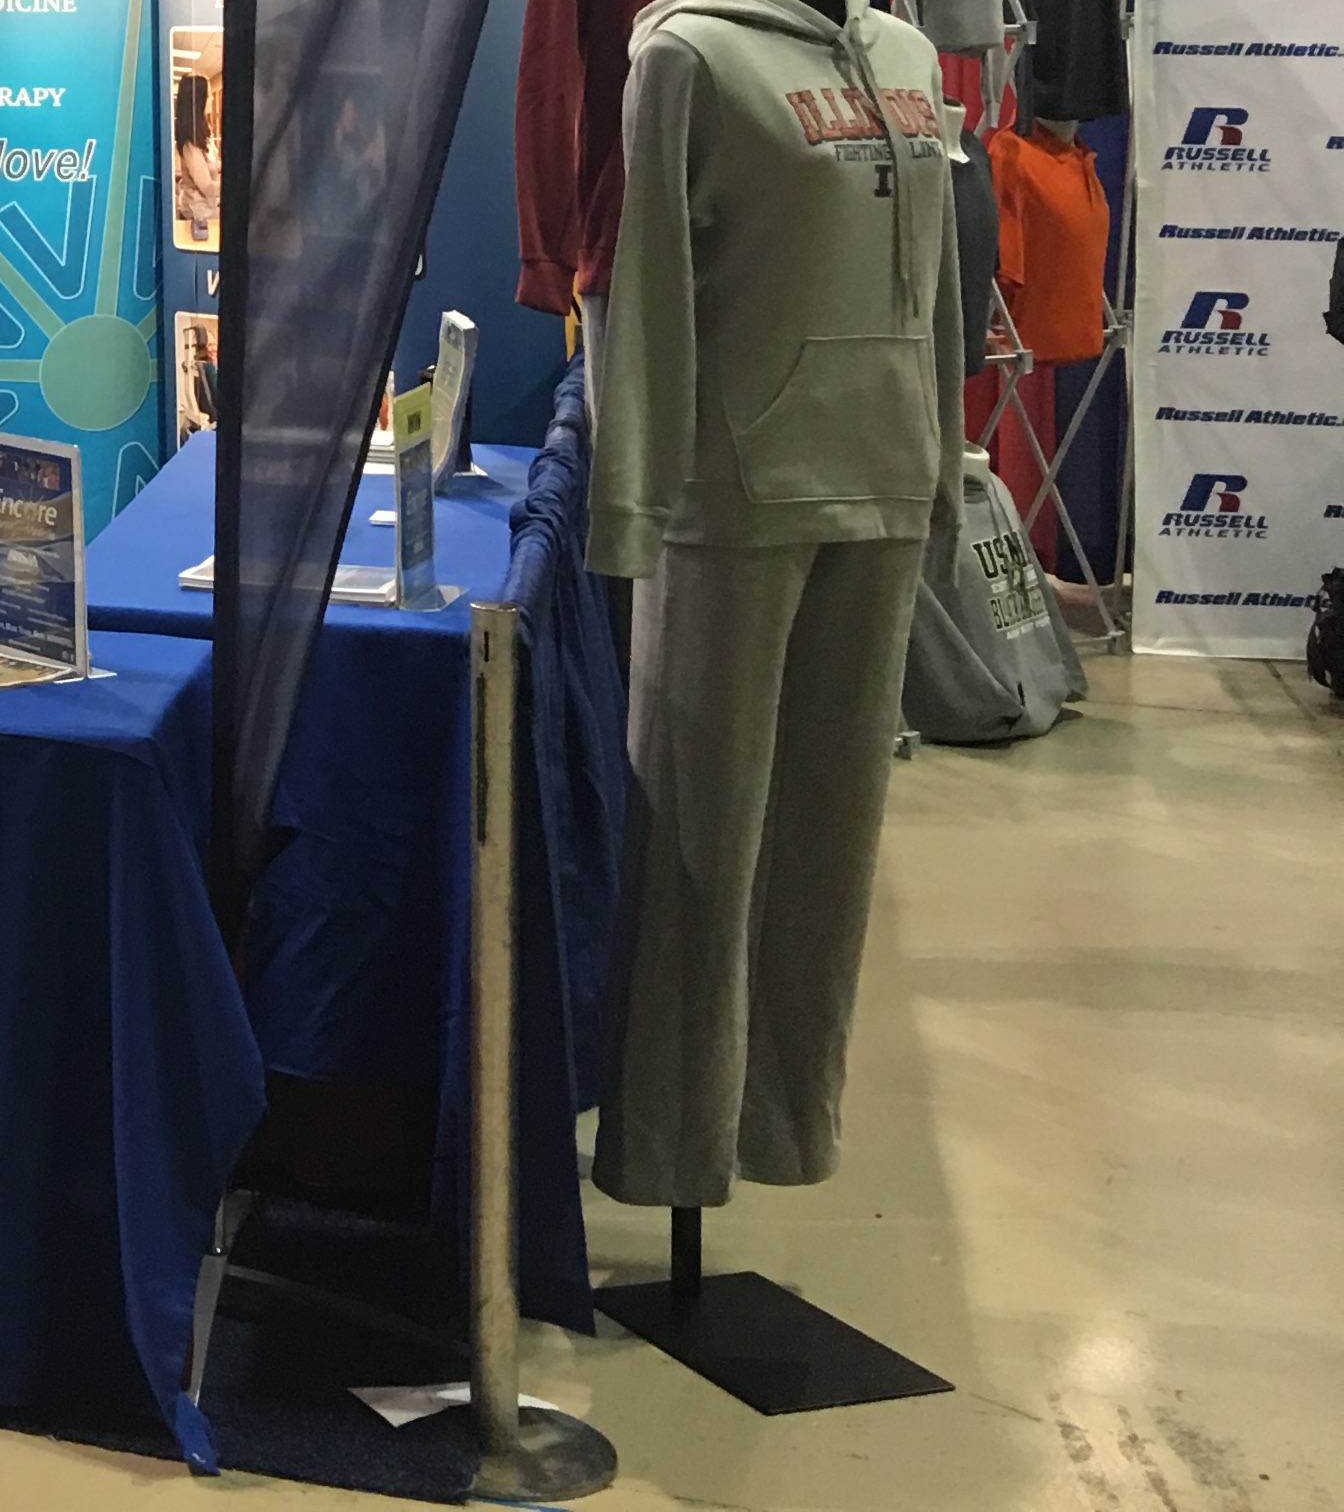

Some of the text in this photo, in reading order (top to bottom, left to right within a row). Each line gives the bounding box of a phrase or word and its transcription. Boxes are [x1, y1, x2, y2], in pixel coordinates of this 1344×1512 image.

[1153, 41, 1244, 55] Russell
[1164, 146, 1271, 162] RUSSELL
[1161, 161, 1270, 172] ATHLETIC
[1159, 224, 1246, 239] Russell
[1161, 330, 1270, 347] RUSSELL
[1158, 345, 1269, 356] ATHLETIC
[1155, 406, 1244, 423] Russell
[1162, 512, 1269, 529] RUSSELL
[1158, 527, 1268, 539] ATHLETIC
[1155, 590, 1242, 605] Russell
